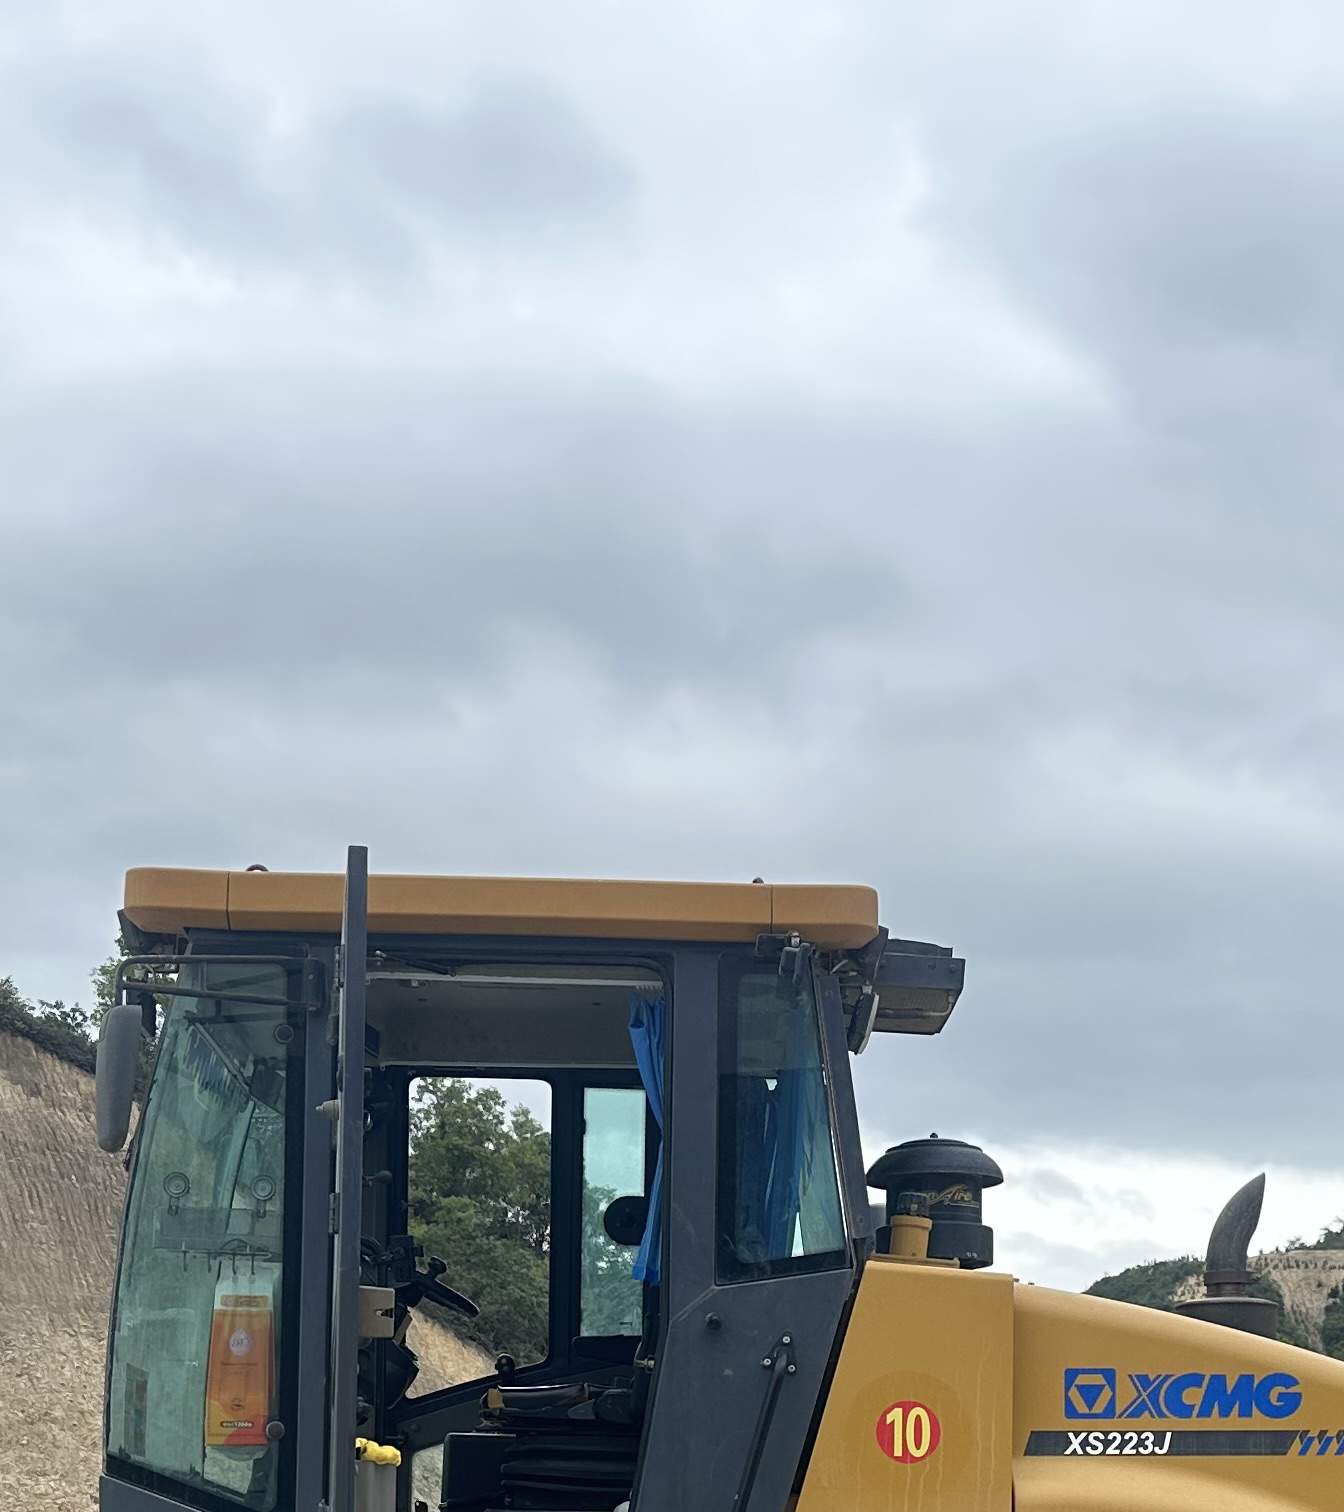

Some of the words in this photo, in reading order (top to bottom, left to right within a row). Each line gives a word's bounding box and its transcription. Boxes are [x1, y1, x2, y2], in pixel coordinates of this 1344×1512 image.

[1116, 1372, 1303, 1419] XCMG
[886, 1406, 931, 1458] 10
[1064, 1431, 1172, 1456] XS223J
